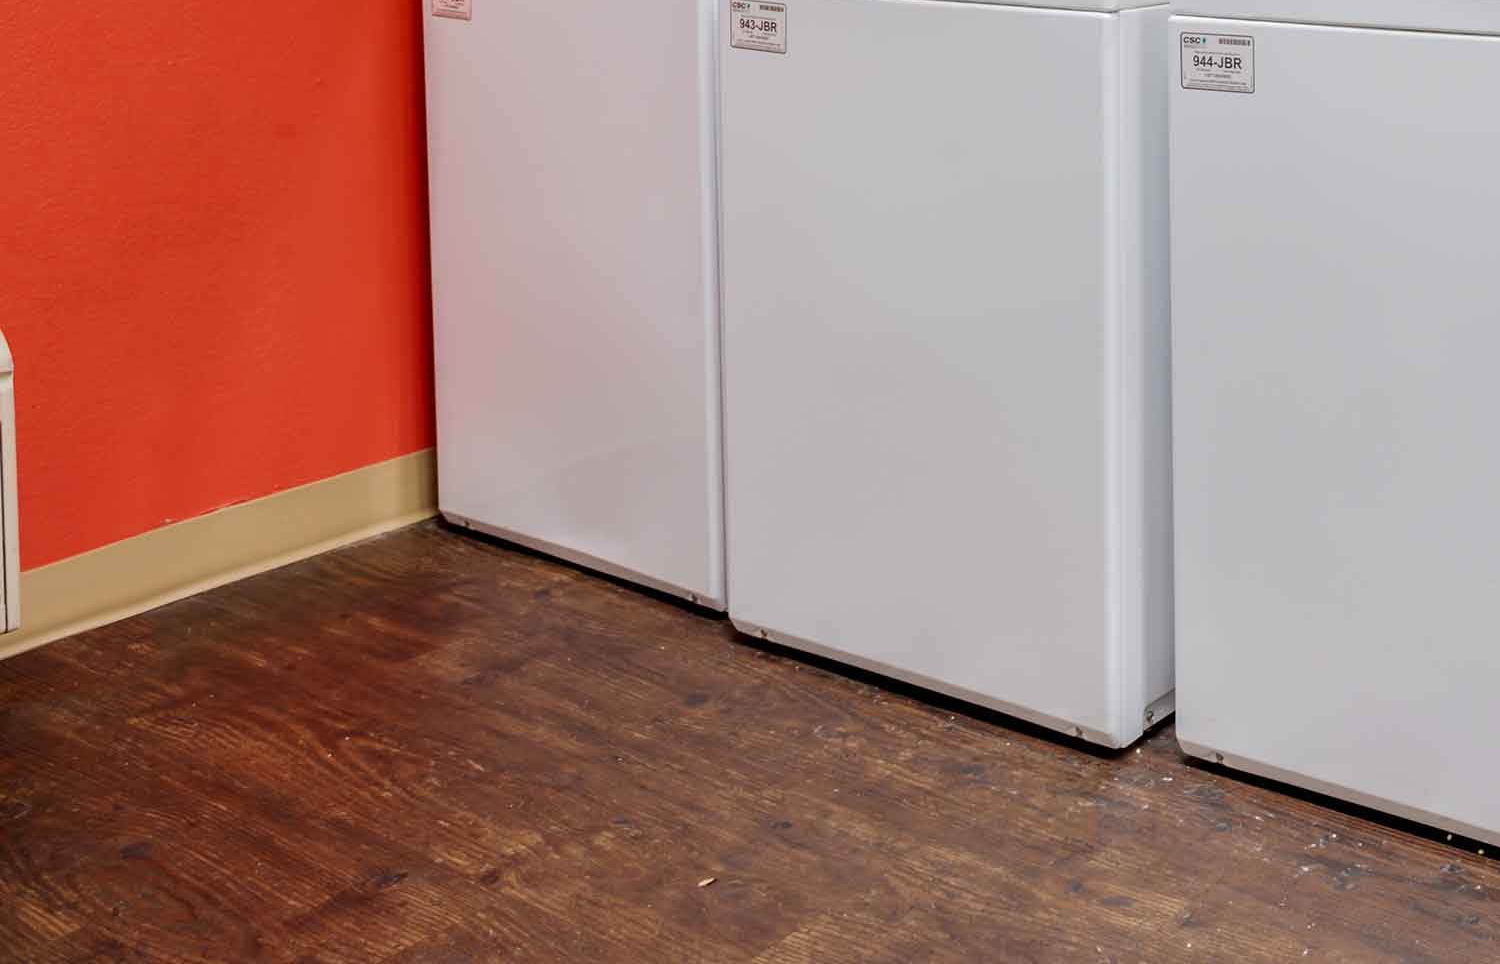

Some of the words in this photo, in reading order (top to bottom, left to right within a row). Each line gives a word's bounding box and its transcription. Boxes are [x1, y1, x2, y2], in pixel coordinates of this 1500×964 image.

[739, 18, 777, 32] 943-JBR
[1183, 36, 1201, 45] CSC
[1192, 54, 1242, 70] 944-JBR
